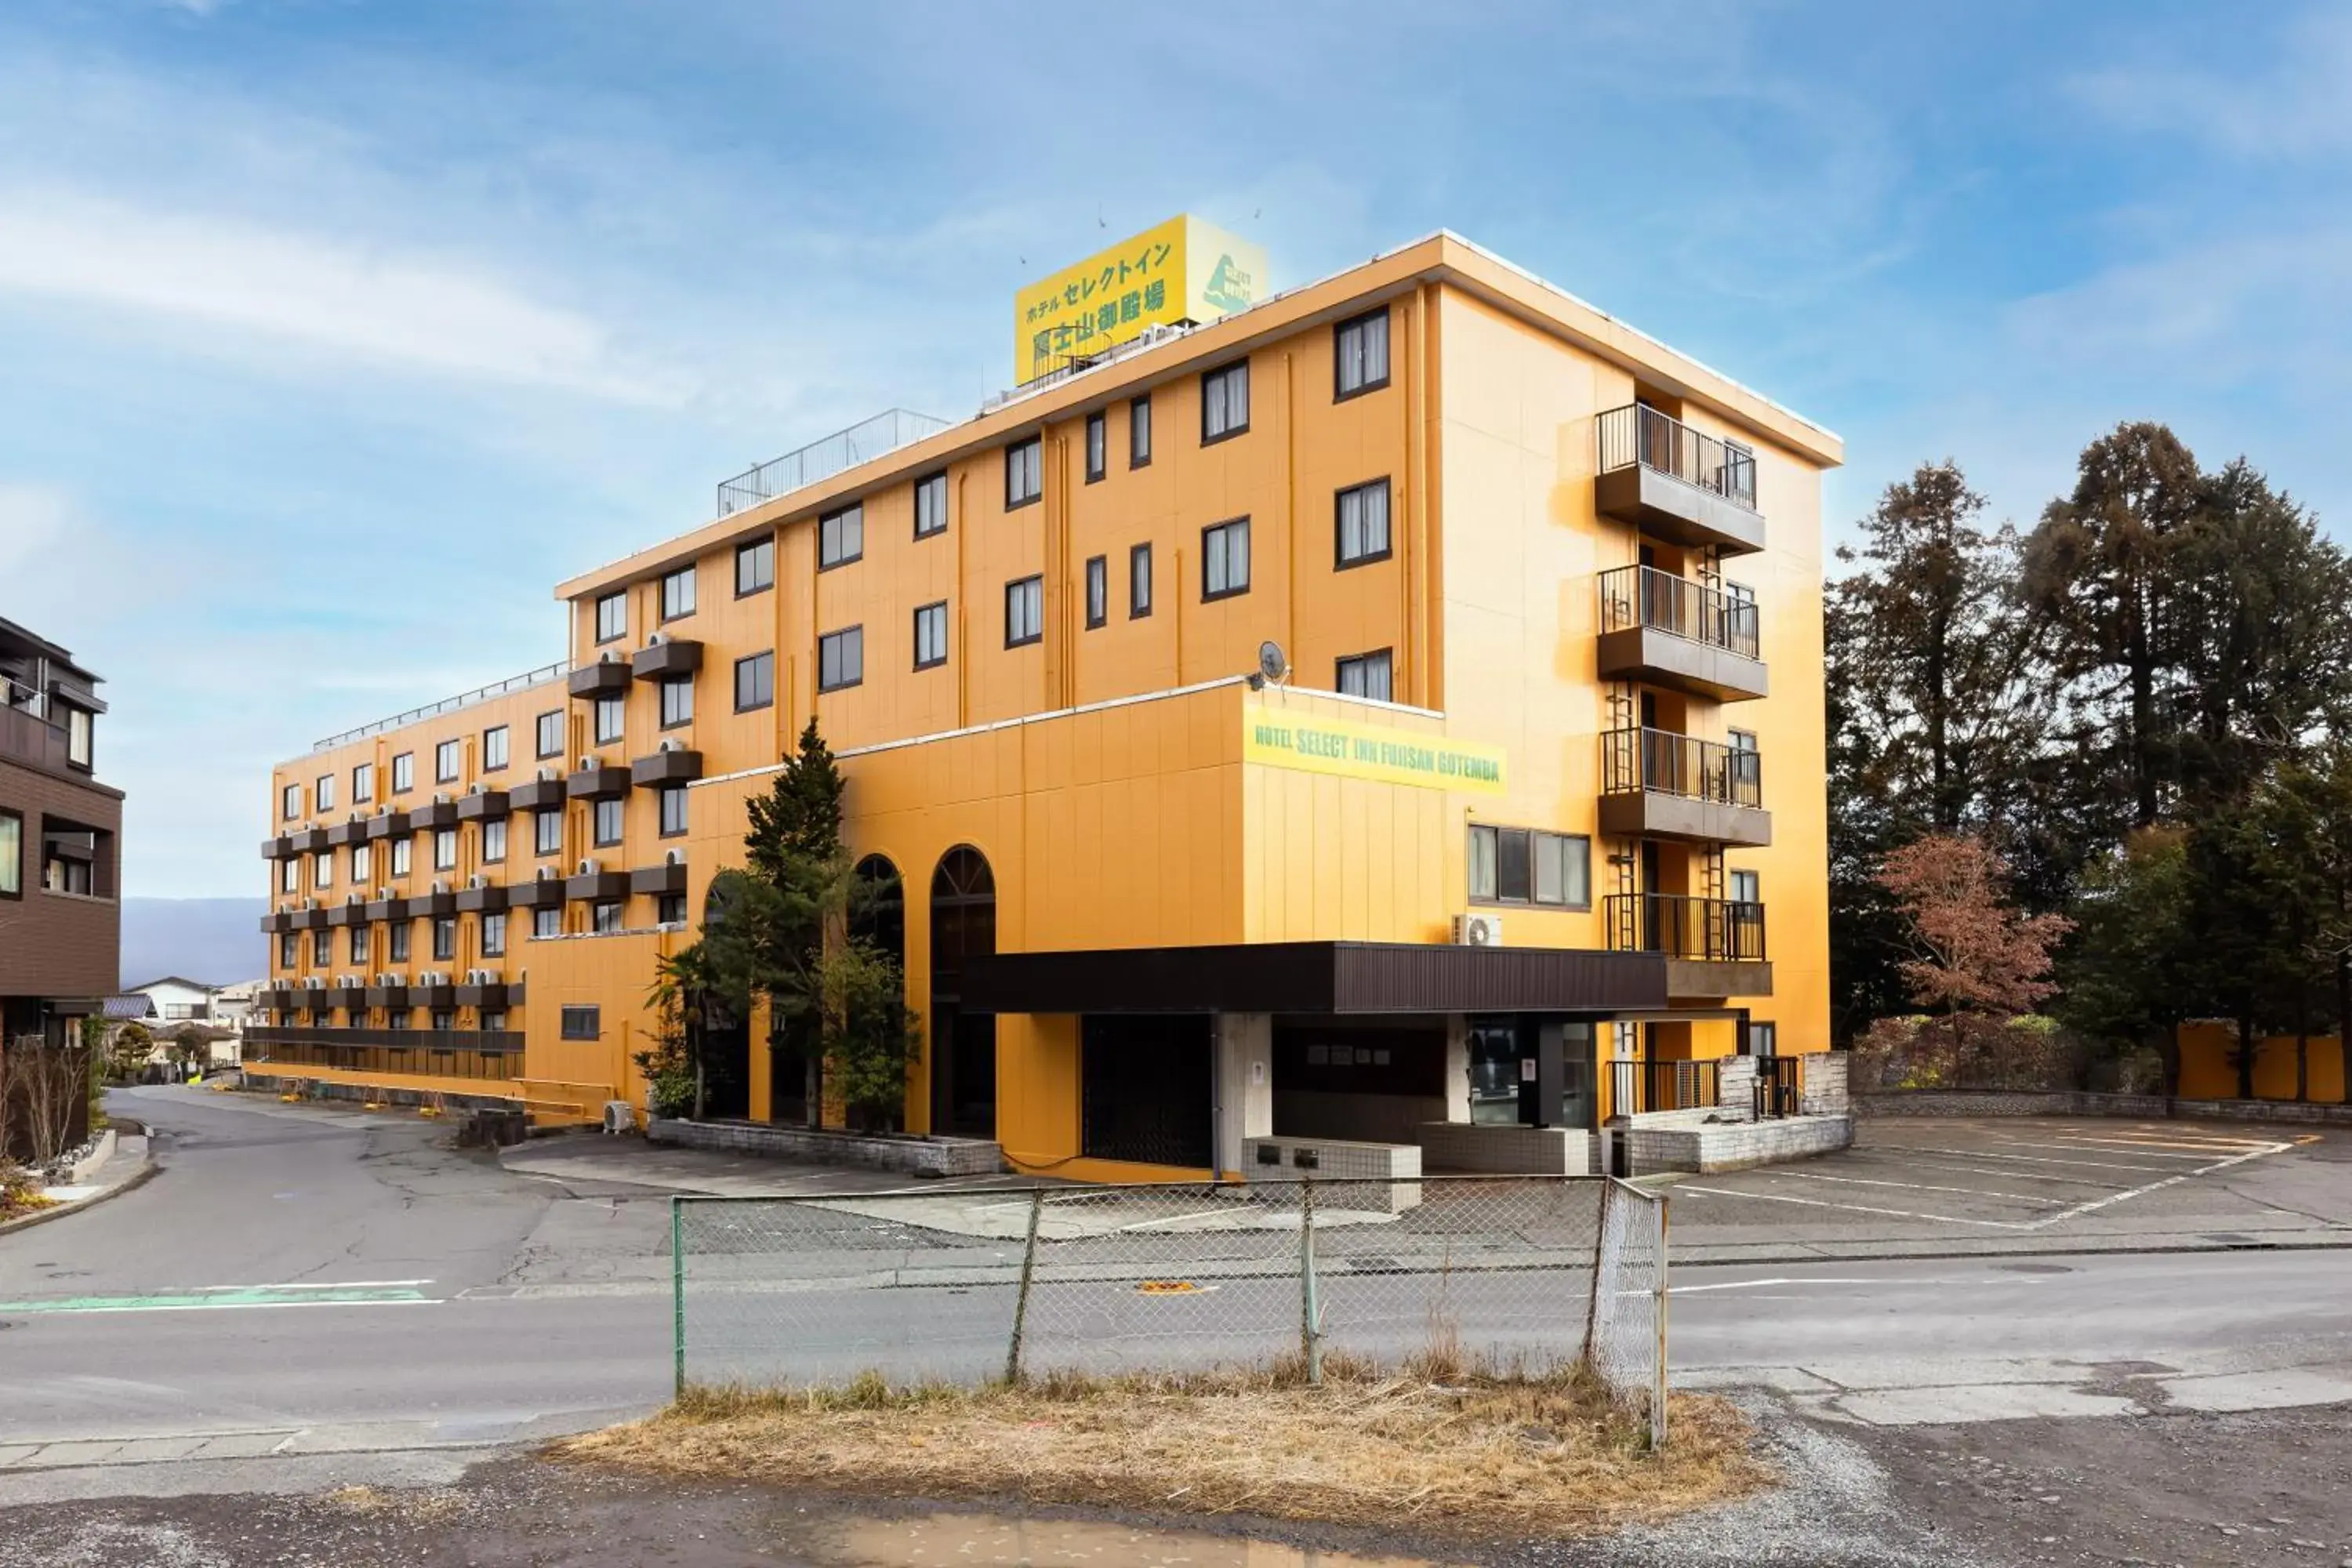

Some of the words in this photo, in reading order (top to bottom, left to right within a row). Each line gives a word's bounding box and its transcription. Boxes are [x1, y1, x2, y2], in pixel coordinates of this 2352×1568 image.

[1026, 296, 1060, 324] ホテル
[1065, 243, 1171, 306] セレクトイン
[1255, 725, 1293, 750] HOTEL
[1297, 728, 1348, 759] SELECT
[1354, 738, 1377, 763] INN
